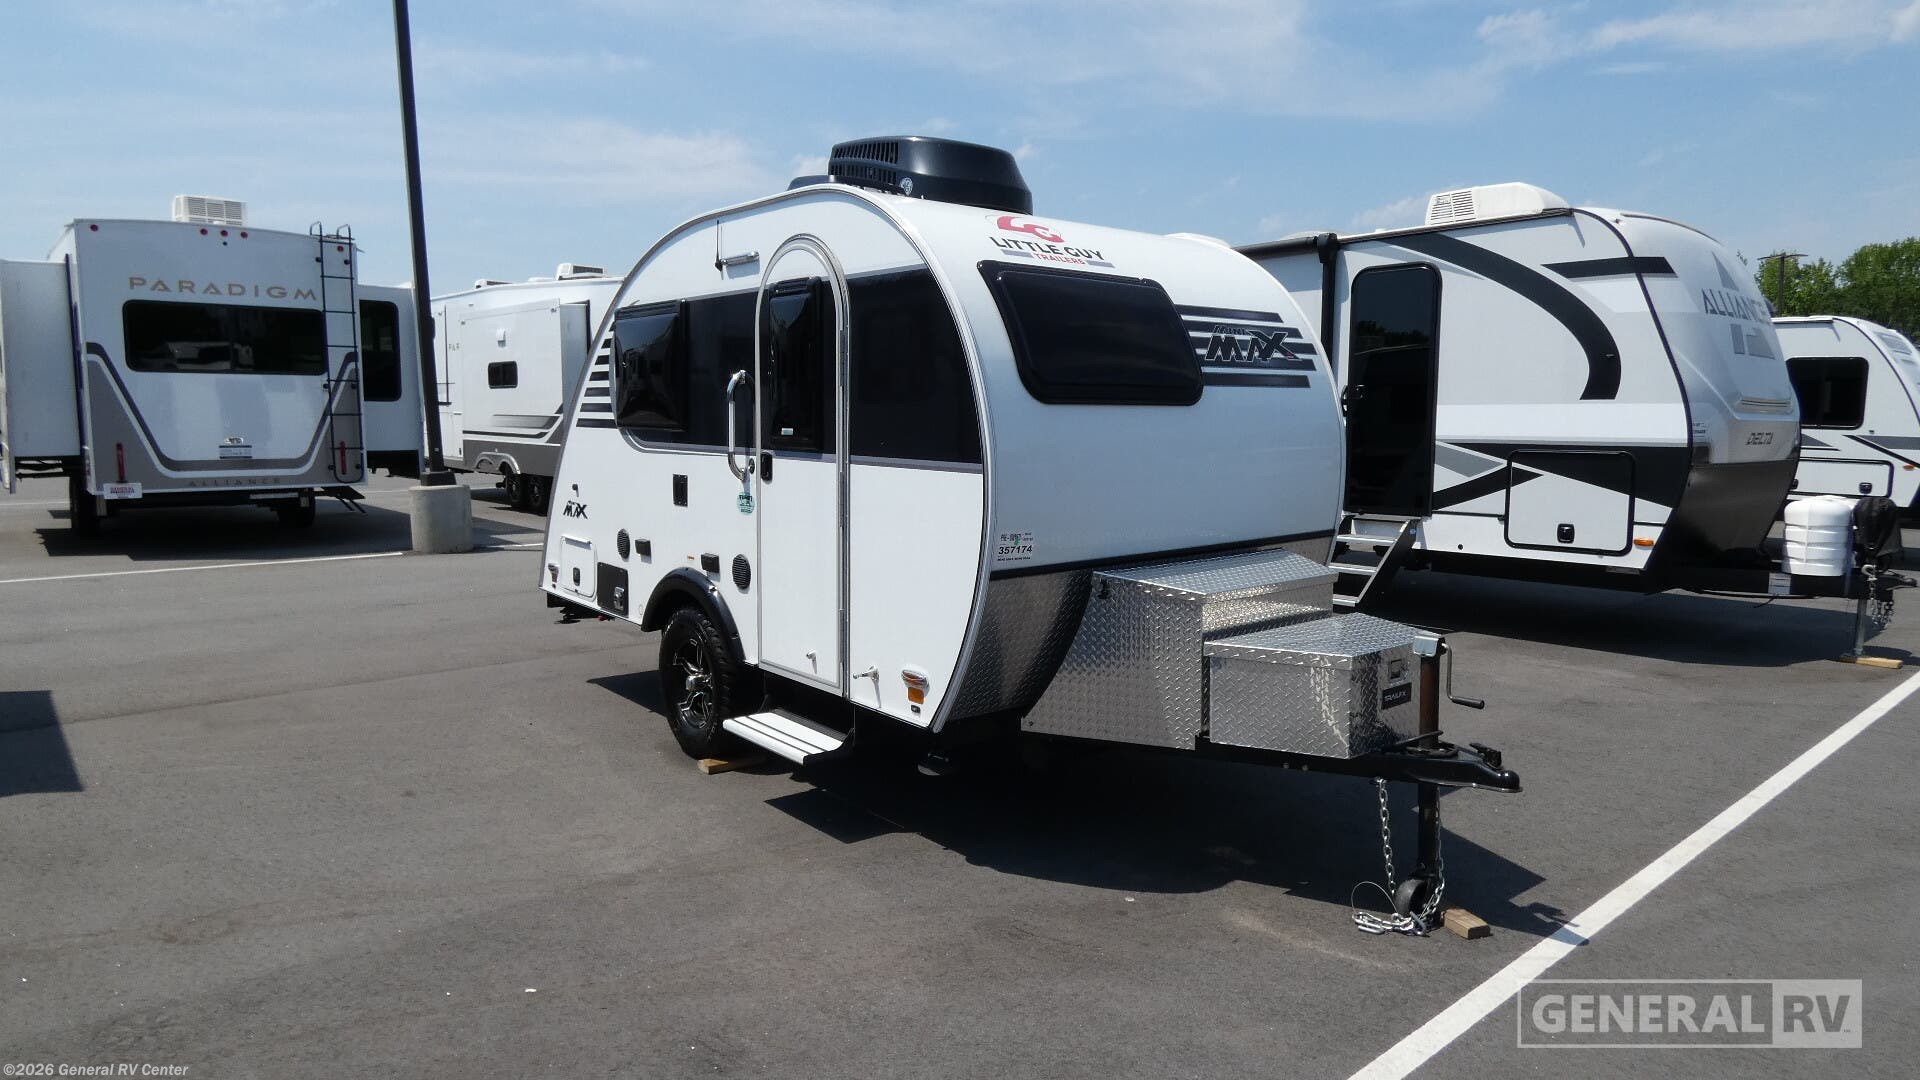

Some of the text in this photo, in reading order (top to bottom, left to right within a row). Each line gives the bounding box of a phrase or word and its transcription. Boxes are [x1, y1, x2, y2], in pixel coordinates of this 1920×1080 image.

[989, 236, 1104, 261] LITTLE GUY
[1033, 252, 1086, 265] TRAILERS
[128, 276, 317, 301] PARADIGM
[1204, 329, 1303, 363] MAX
[188, 475, 282, 488] ALLIANCE
[562, 502, 588, 520] MAX
[998, 544, 1033, 555] 357174
